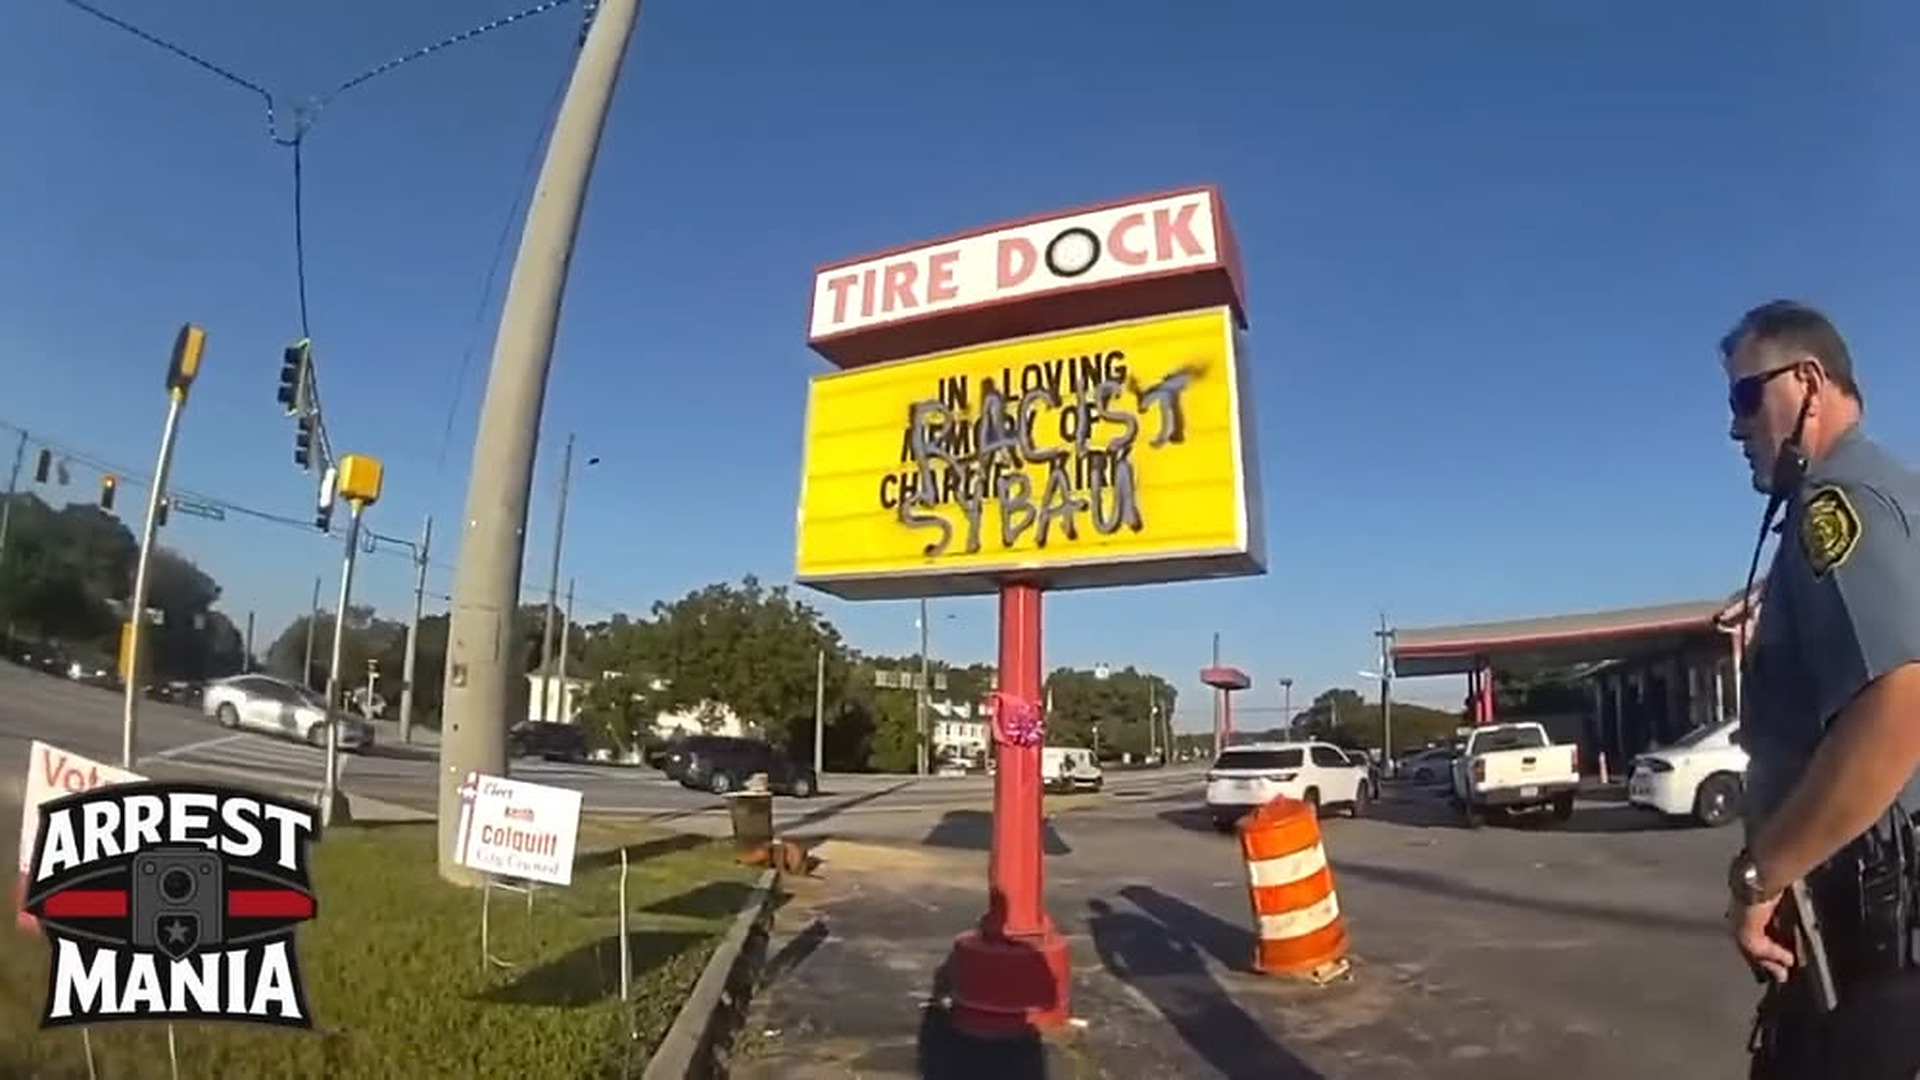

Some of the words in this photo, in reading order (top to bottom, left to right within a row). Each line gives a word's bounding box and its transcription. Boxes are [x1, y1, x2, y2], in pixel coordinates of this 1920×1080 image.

[826, 248, 960, 324] TIRE
[996, 203, 1206, 289] DOCK
[938, 375, 968, 411] IN
[1003, 351, 1127, 403] LOVING
[1059, 402, 1101, 443] OF
[908, 360, 1210, 503] RACIST
[898, 450, 1143, 556] SYBAU
[44, 749, 108, 793] Vot
